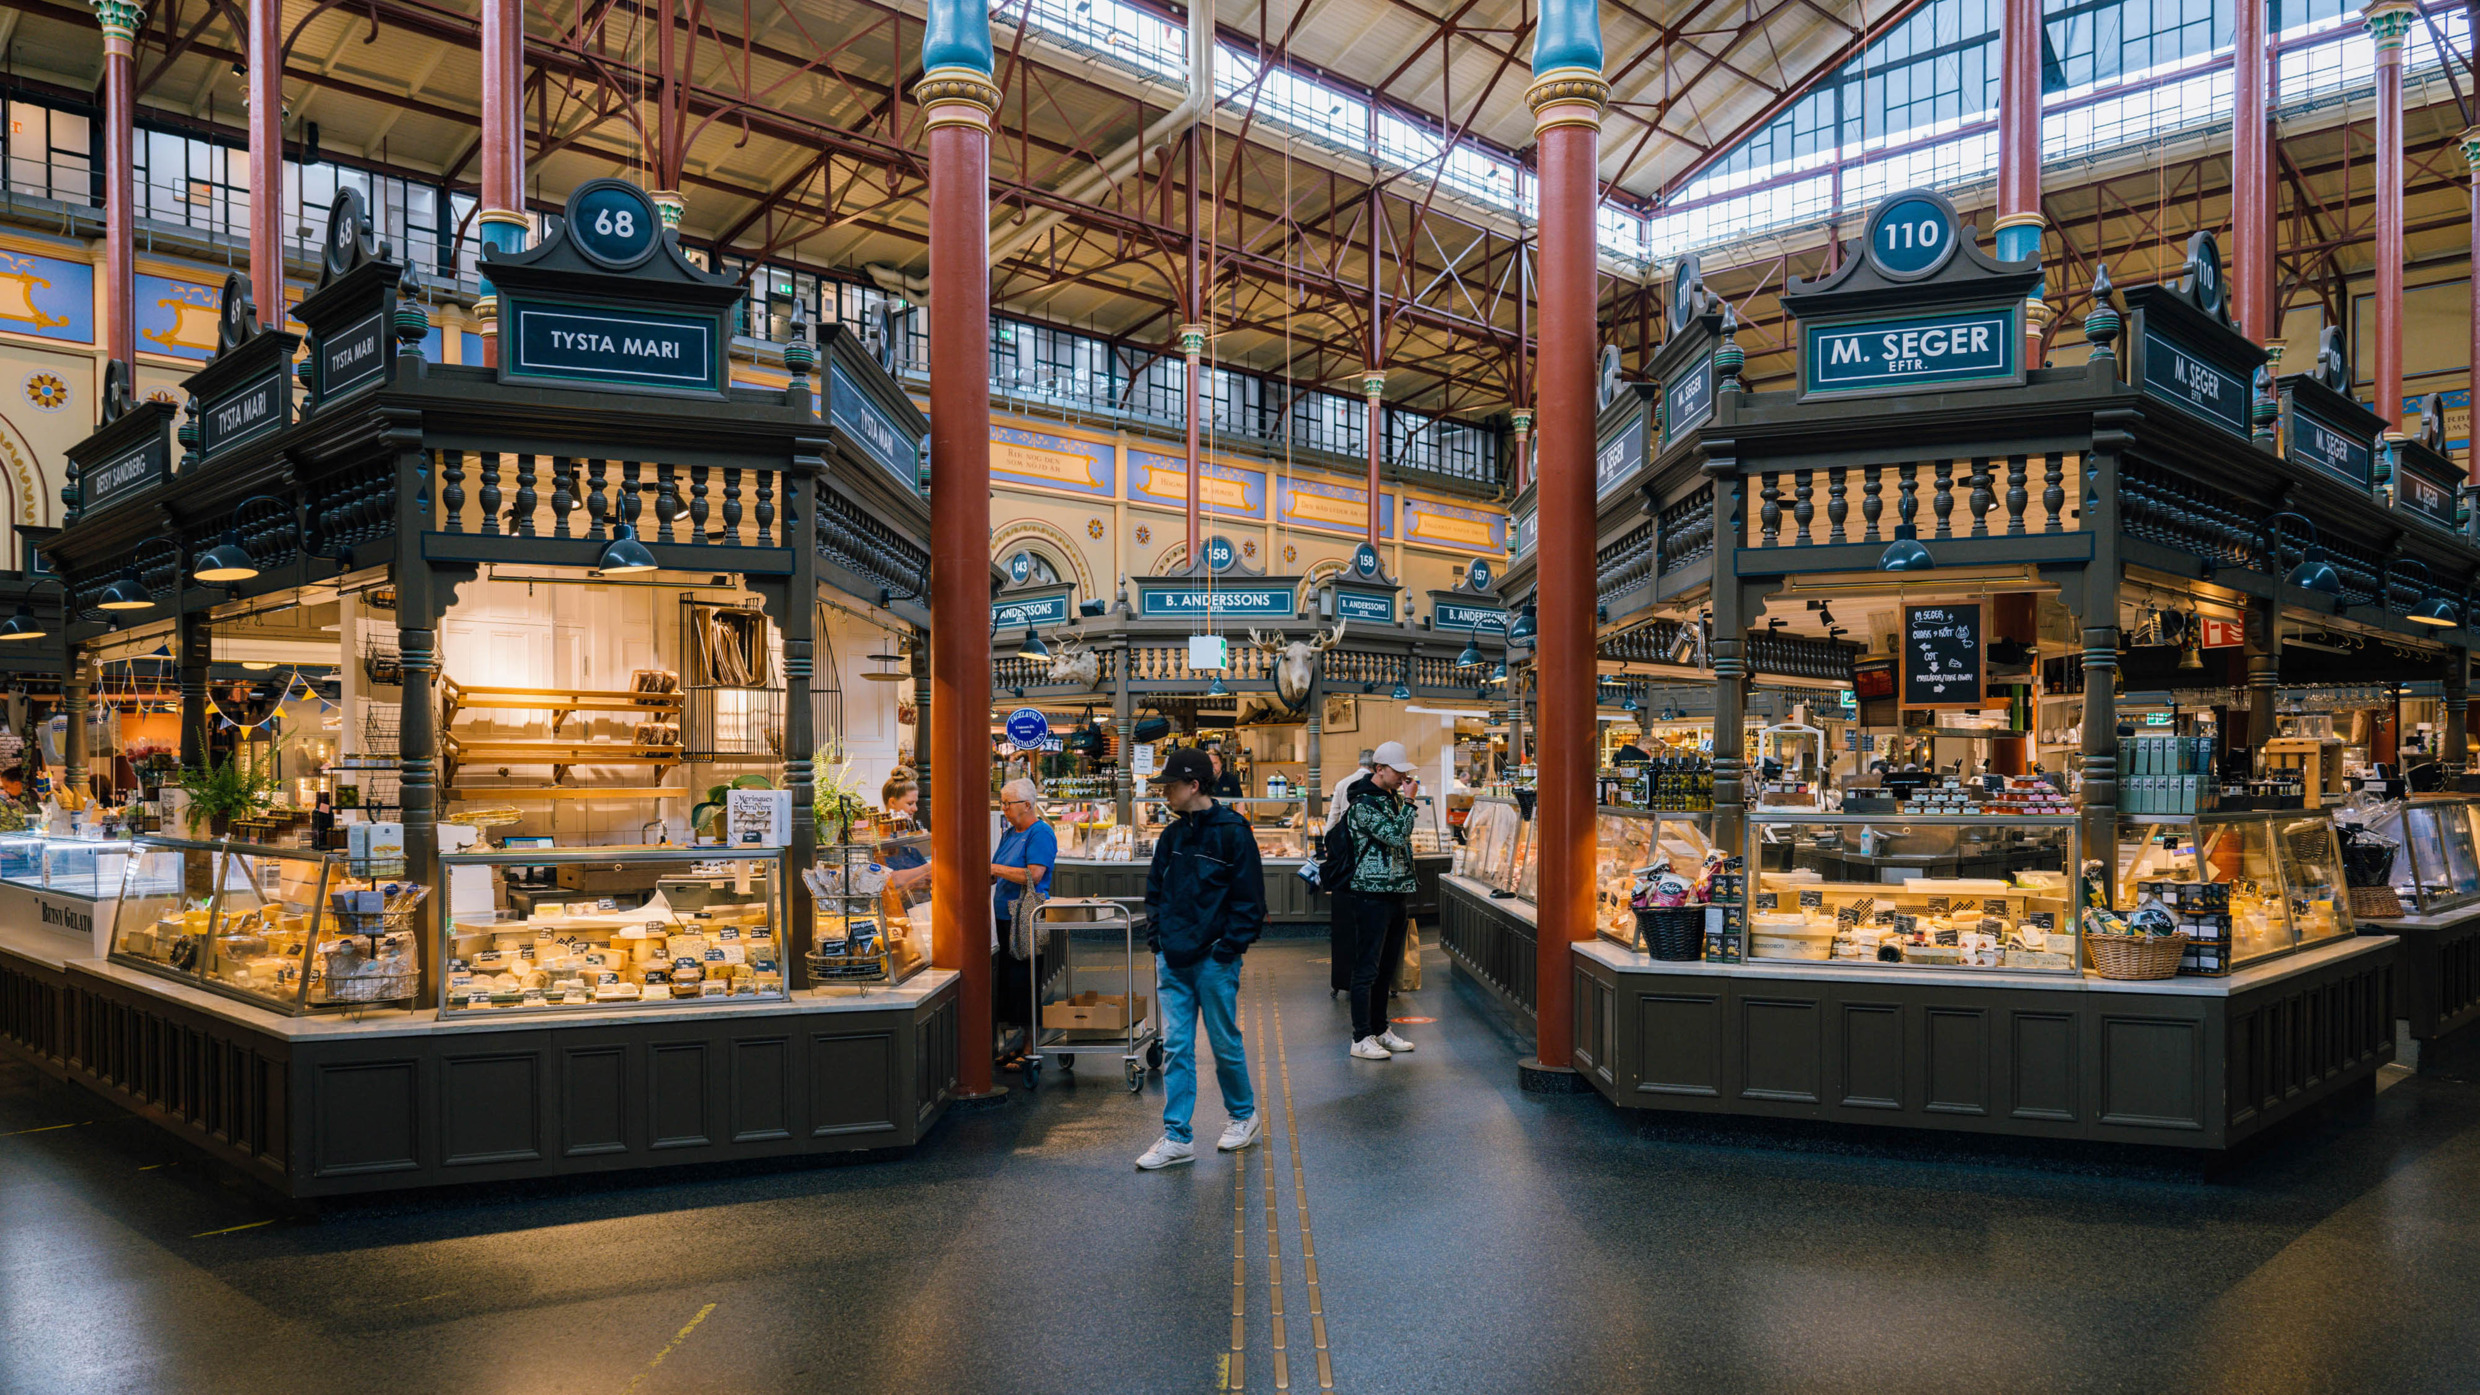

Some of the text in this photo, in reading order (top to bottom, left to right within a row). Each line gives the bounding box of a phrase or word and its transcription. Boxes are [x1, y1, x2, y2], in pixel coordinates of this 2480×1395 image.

[338, 217, 353, 249] 68
[594, 208, 635, 238] 68
[1885, 221, 1939, 250] 110
[2198, 258, 2214, 291] 110
[1678, 281, 1690, 309] 111
[230, 299, 242, 325] 69
[331, 336, 375, 371] TYSTA MARI
[551, 330, 680, 360] TYSTA MARI
[1830, 325, 1990, 365] M. SEGER
[1888, 359, 1929, 372] EFTR.
[2329, 349, 2341, 372] 109
[1604, 367, 1613, 391] 111
[1677, 375, 1702, 408] M. SEGER
[2174, 355, 2219, 402] M. SEGER
[110, 383, 119, 403] 70
[218, 391, 267, 436] TYSTA MARI
[860, 408, 894, 457] TYSTA MARI
[2315, 428, 2348, 463] M. SEGER
[1598, 441, 1624, 478] M. SEGER
[95, 453, 146, 495] BETSY SANDBERG
[2415, 482, 2438, 509] M. SEGER
[1014, 562, 1028, 574] 143
[1359, 555, 1374, 568] 158
[1474, 569, 1487, 581] 157
[1000, 603, 1053, 619] ANDERSSONS
[1166, 594, 1271, 607] B. ANDERSSONS
[1342, 600, 1386, 612] B. ANDERSSONS
[1449, 610, 1508, 625] B. ANDERSSONS
[1923, 610, 1944, 621] SEGER
[1924, 651, 1939, 661] OST
[41, 901, 93, 934] BETSY GELATO
